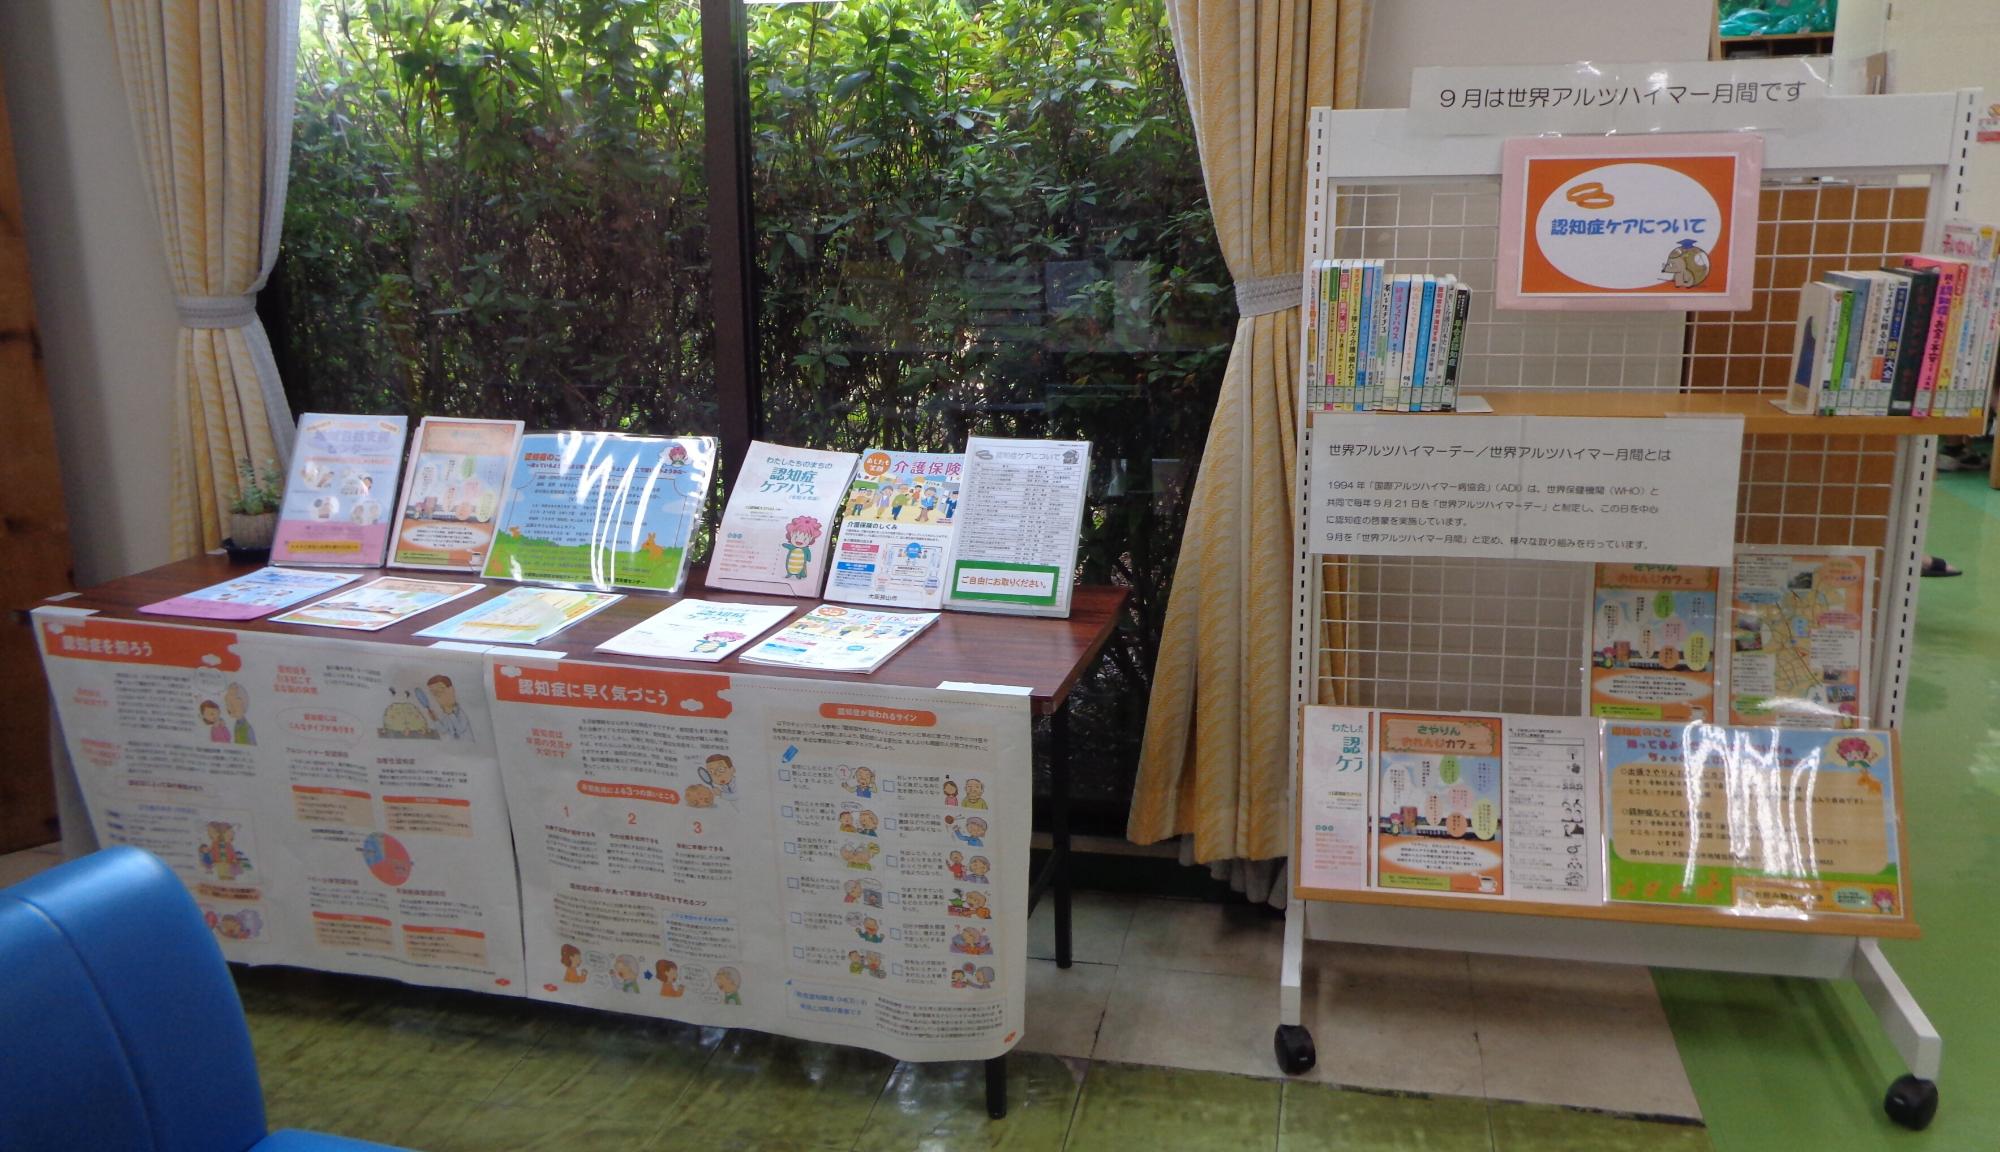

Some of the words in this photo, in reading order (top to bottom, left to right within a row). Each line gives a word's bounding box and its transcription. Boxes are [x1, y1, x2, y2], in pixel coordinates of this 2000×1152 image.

[1550, 215, 1707, 237] 認知症ケアについて
[766, 456, 833, 469] わたしたちのまちの
[892, 460, 962, 476] 介護保険
[769, 466, 818, 484] 認知症
[759, 480, 815, 495] ケアパス
[960, 575, 1047, 589] ご自由にお取りください。
[517, 679, 669, 707] 認知症に早く気づこう
[1416, 724, 1461, 737] さやりん
